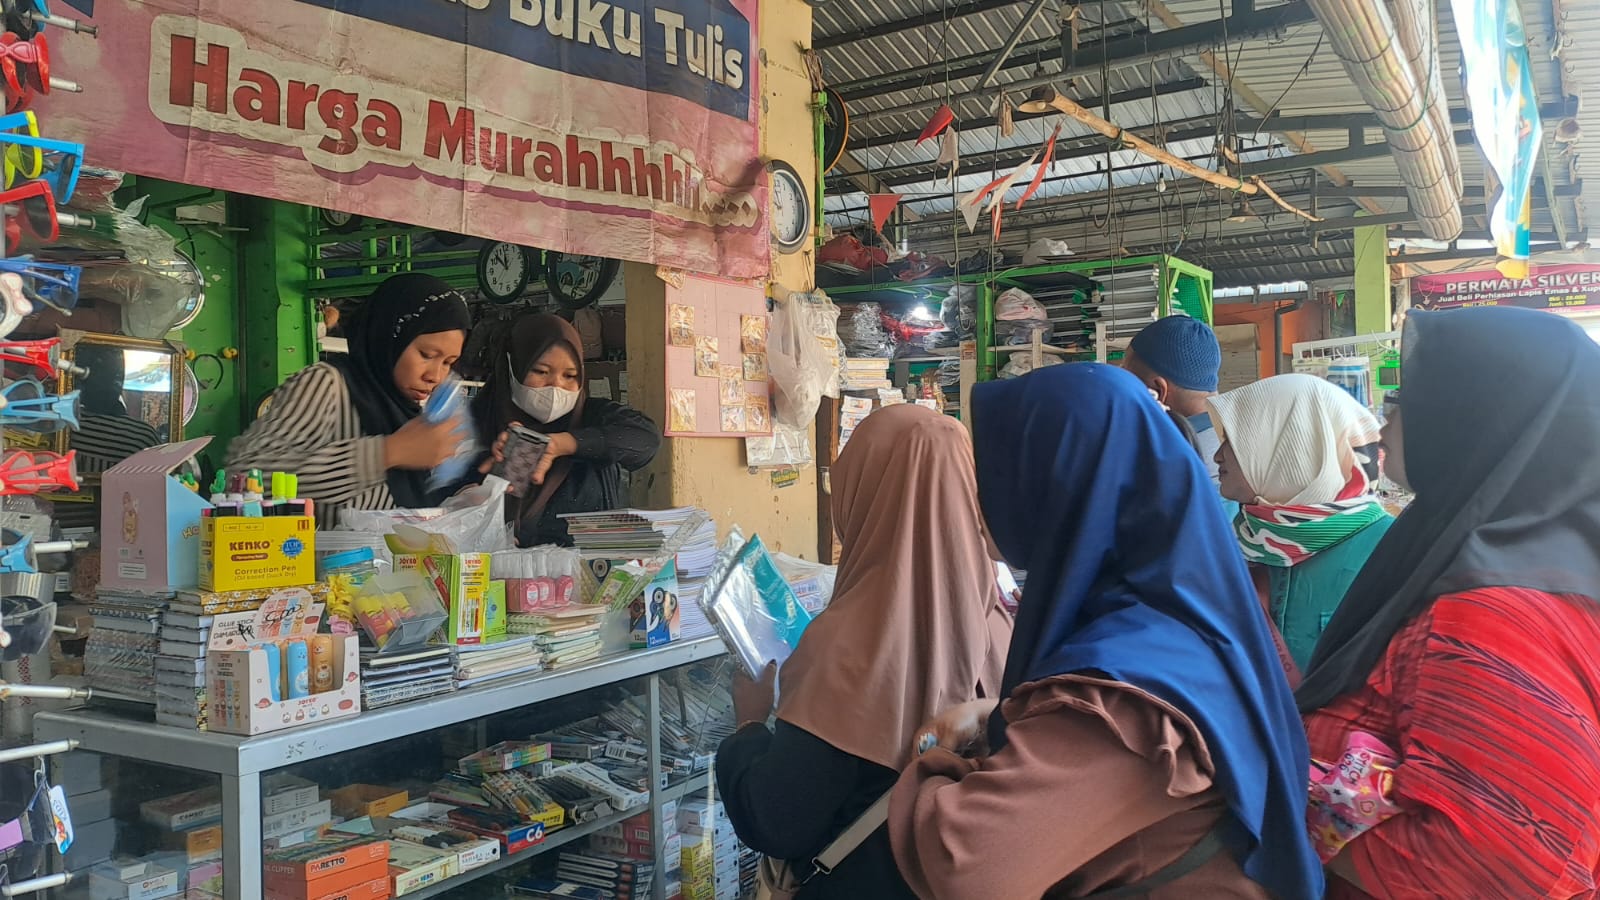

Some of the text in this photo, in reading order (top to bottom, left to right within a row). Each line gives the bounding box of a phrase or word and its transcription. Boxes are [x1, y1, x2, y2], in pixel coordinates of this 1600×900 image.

[655, 8, 744, 89] Tulis
[169, 35, 402, 156] Harga
[1446, 271, 1600, 294] PERMATA SILVER
[229, 540, 270, 551] KENKO
[234, 566, 279, 575] Correction
[526, 828, 543, 842] C6
[310, 857, 346, 873] PARETTO
